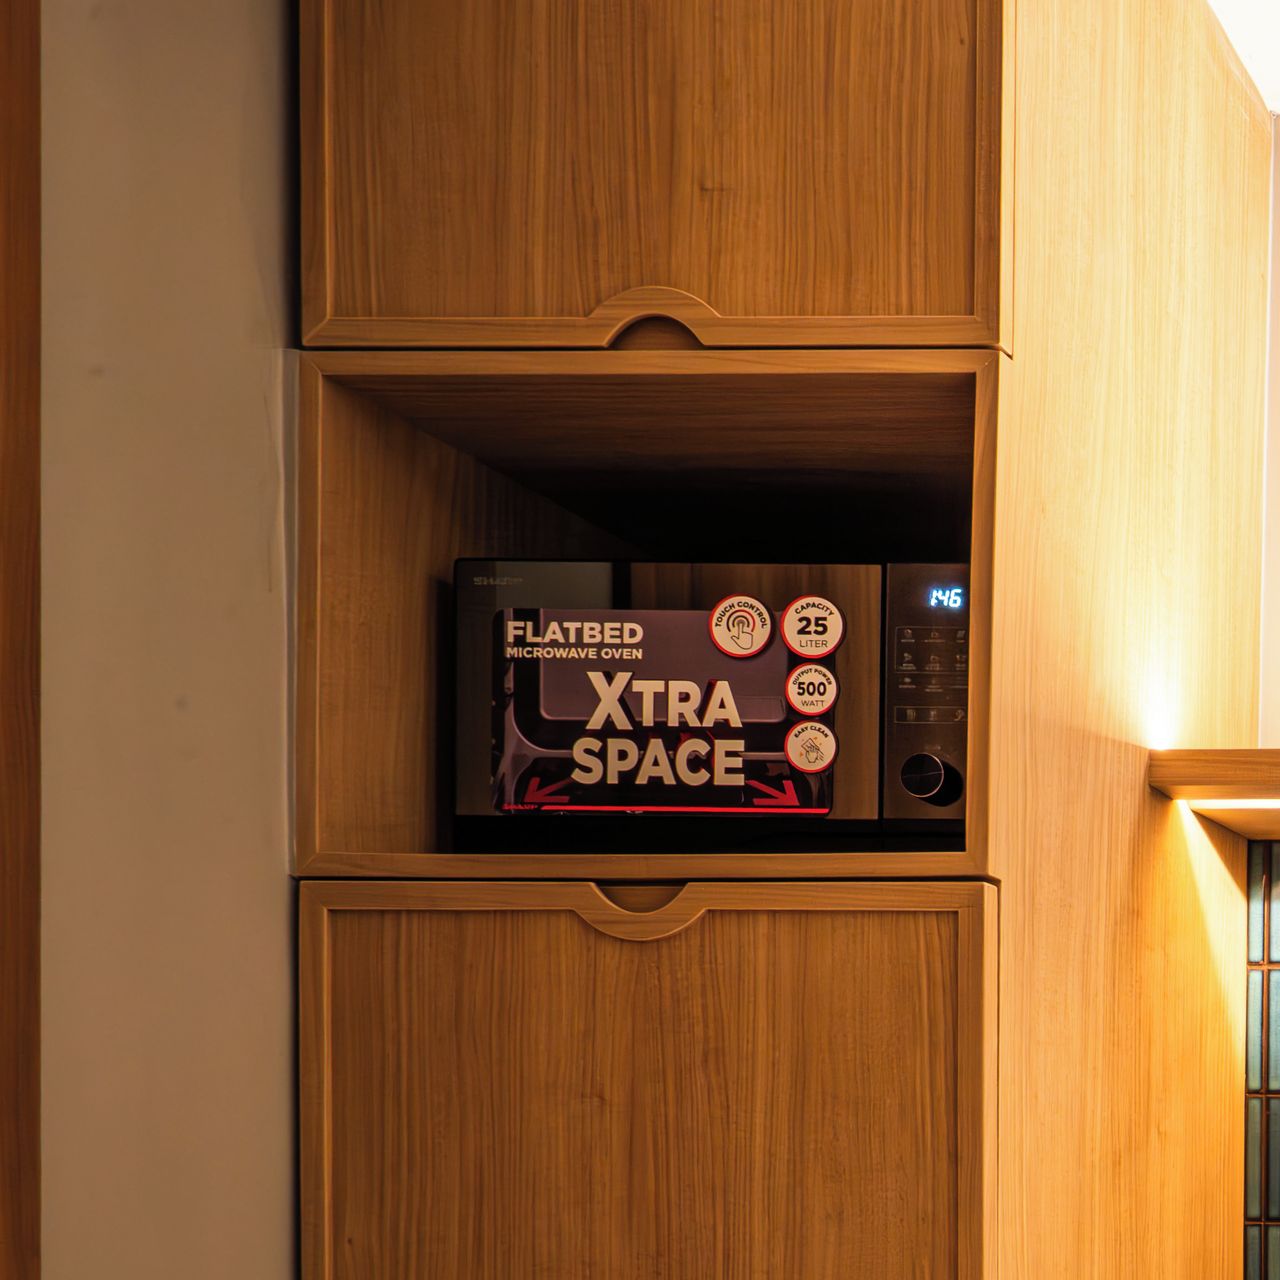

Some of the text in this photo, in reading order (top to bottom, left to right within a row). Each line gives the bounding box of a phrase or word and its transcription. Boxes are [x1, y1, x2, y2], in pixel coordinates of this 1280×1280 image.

[715, 601, 768, 629] TOUCH CONTROL
[794, 602, 835, 616] CAPACITY
[506, 621, 644, 644] FLATBED
[797, 616, 829, 635] 25
[799, 639, 828, 648] LITER
[505, 647, 644, 660] MICROWAVE OVEN
[792, 668, 833, 686] OUTPUT POWER
[796, 682, 827, 697] 500
[585, 671, 743, 730] XTRA
[800, 699, 826, 707] WATT
[793, 725, 829, 739] EASY CLEAN
[570, 737, 745, 786] SPACE
